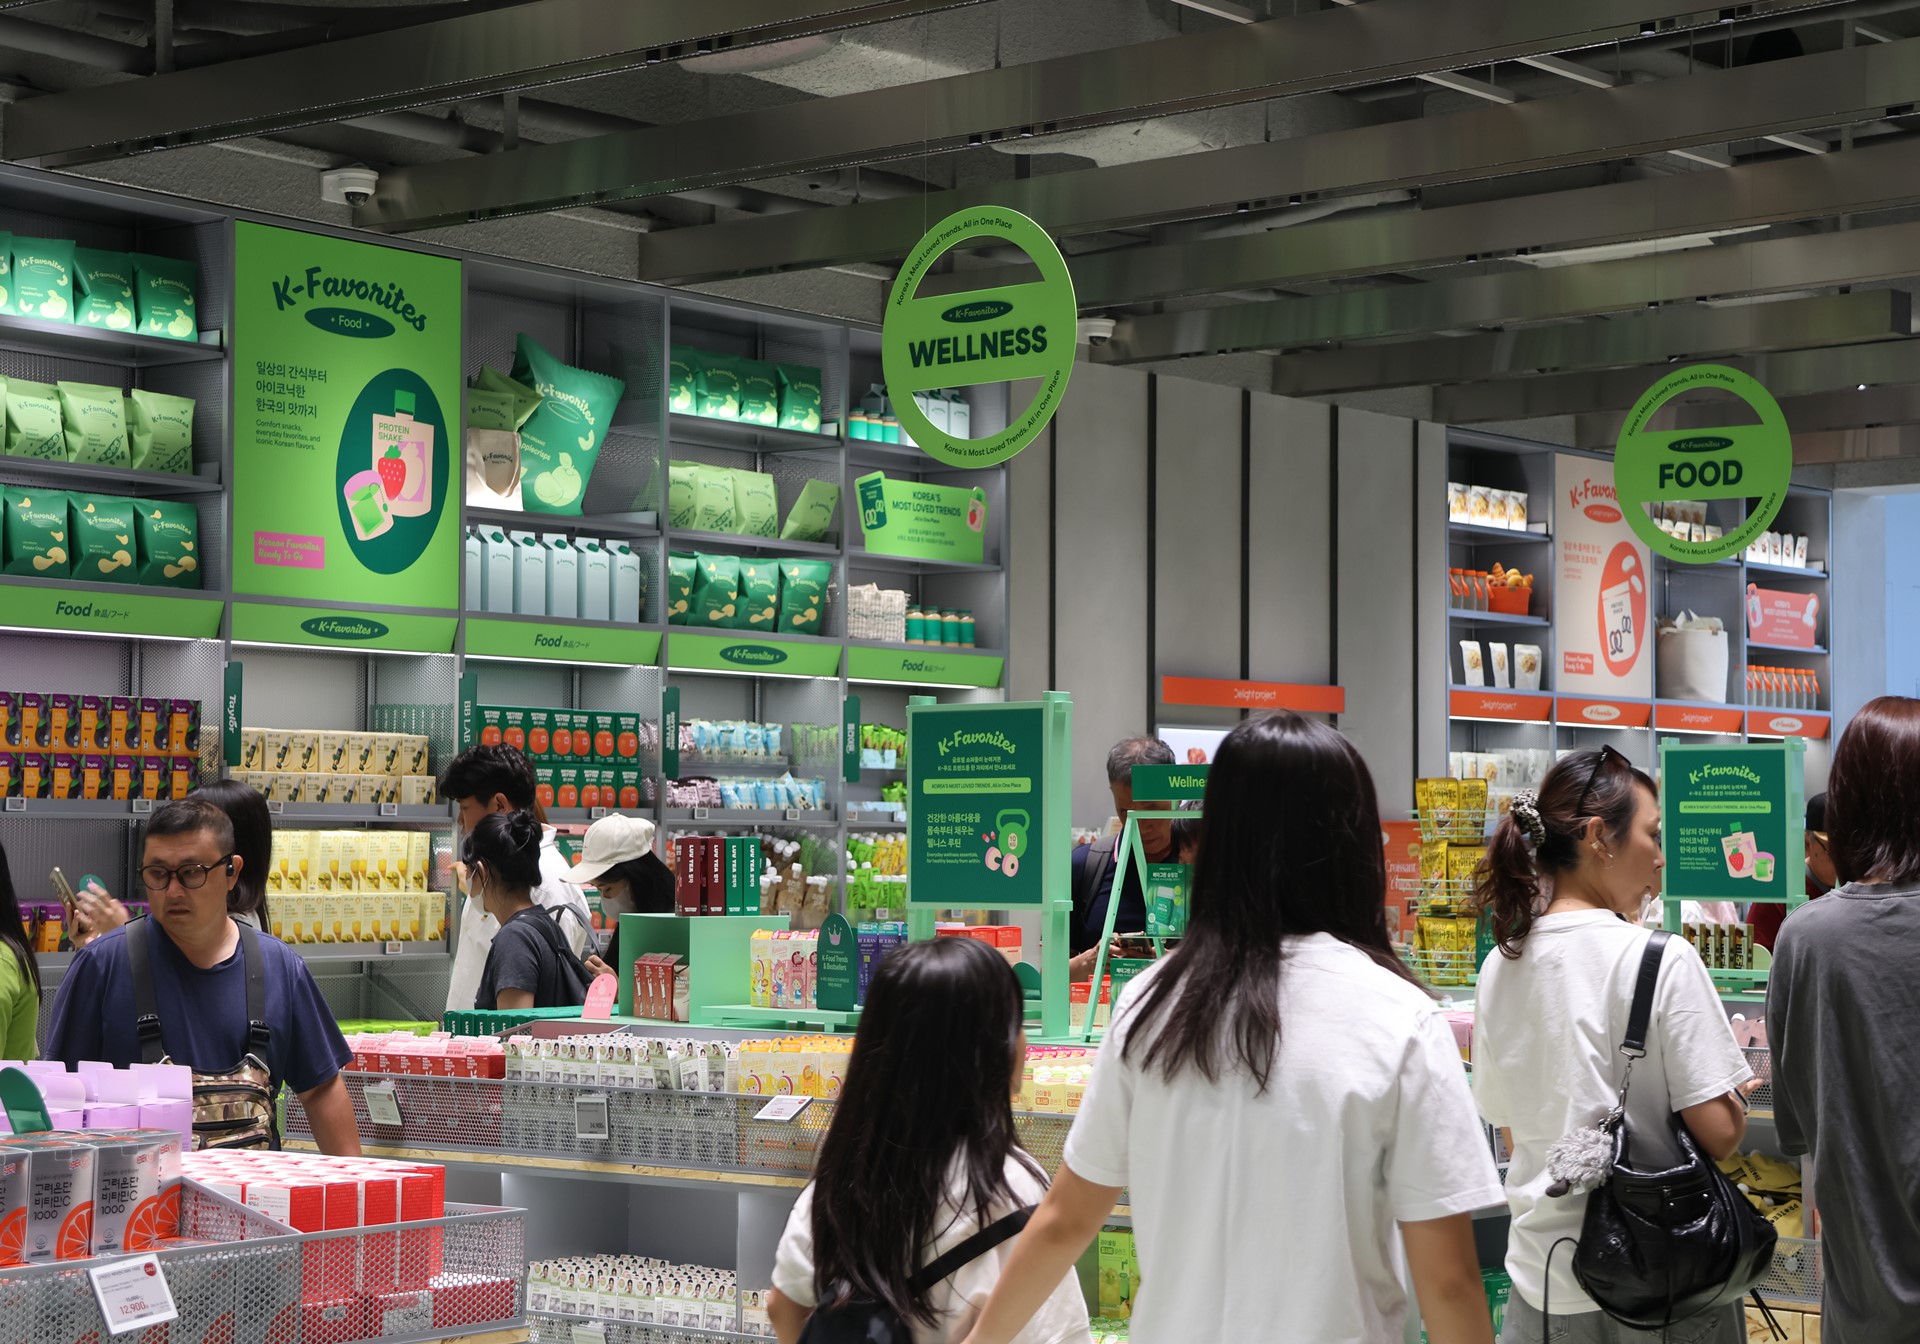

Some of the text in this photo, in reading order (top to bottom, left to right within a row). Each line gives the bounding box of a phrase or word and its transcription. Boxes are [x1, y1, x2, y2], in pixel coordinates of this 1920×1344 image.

[20, 256, 65, 273] K-Favorites
[896, 276, 912, 305] Korea's
[910, 258, 924, 275] Most
[923, 236, 941, 258] Loved
[963, 219, 973, 228] All
[973, 218, 979, 226] in
[980, 217, 994, 226] One
[995, 218, 1013, 230] Place
[272, 266, 427, 332] K-Favorites
[955, 304, 998, 319] K-Favorites
[338, 315, 362, 329] Food
[909, 325, 1048, 368] WELLNESS
[256, 361, 327, 383] 일상의 간식부터
[256, 380, 305, 399] 아이코닉한
[256, 398, 317, 418] 한국의 맛까지
[535, 383, 596, 425] K-Favorites
[1627, 412, 1641, 437] Korea's
[1640, 399, 1653, 414] Most
[1652, 386, 1669, 401] Loved
[1719, 373, 1735, 384] Place
[944, 443, 967, 457] Korea's
[968, 448, 985, 457] Most
[986, 443, 1005, 455] Loved
[1027, 416, 1036, 428] All
[1034, 408, 1042, 419] in
[1040, 392, 1052, 410] One
[1049, 369, 1061, 393] Place
[255, 419, 280, 429] Comfort
[378, 422, 410, 434] PROTEIN
[255, 429, 282, 439] everyday
[378, 432, 403, 442] SHAKE
[274, 440, 294, 448] Korean
[1680, 440, 1720, 449] K-Favorites
[520, 443, 551, 461] pplecrisps
[1658, 460, 1743, 489] FOOD
[912, 490, 941, 502] KOREA'S
[892, 501, 961, 517] MOST LOVED TRENDS
[21, 511, 63, 525] K-Favorites
[88, 516, 127, 528] K-Favorites
[1669, 543, 1691, 555] Korea's
[1691, 548, 1707, 556] Most
[1707, 543, 1726, 555] Loved
[1746, 524, 1754, 536] All
[1752, 520, 1759, 530] in
[1757, 508, 1769, 523] One
[1765, 492, 1777, 511] Place
[152, 521, 192, 535] K-Favorites
[258, 537, 285, 547] Korean
[258, 548, 281, 561] Ready
[56, 601, 130, 618] Food 食品/フード
[318, 621, 371, 635] K-Favorites
[534, 634, 562, 648] Food
[732, 649, 775, 661] K-Favorites
[901, 659, 924, 672] Food
[464, 700, 471, 721] BB
[938, 730, 1016, 756] K-Favorites
[1689, 764, 1760, 784] K-Favorites
[1168, 776, 1208, 788] Wellne
[927, 813, 981, 823] 건강한 아름다움을
[927, 826, 974, 836] 몸속부터 채우는
[927, 838, 961, 848] 웰니스 루틴
[822, 954, 835, 962] K-Food
[827, 963, 847, 971] Bestsellers
[35, 1182, 72, 1196] 고려은단
[102, 1177, 139, 1191] 고려은단
[34, 1195, 70, 1209] 비타민C
[102, 1190, 138, 1203] 비타민C
[34, 1210, 58, 1220] 1000
[101, 1205, 125, 1215] 1000
